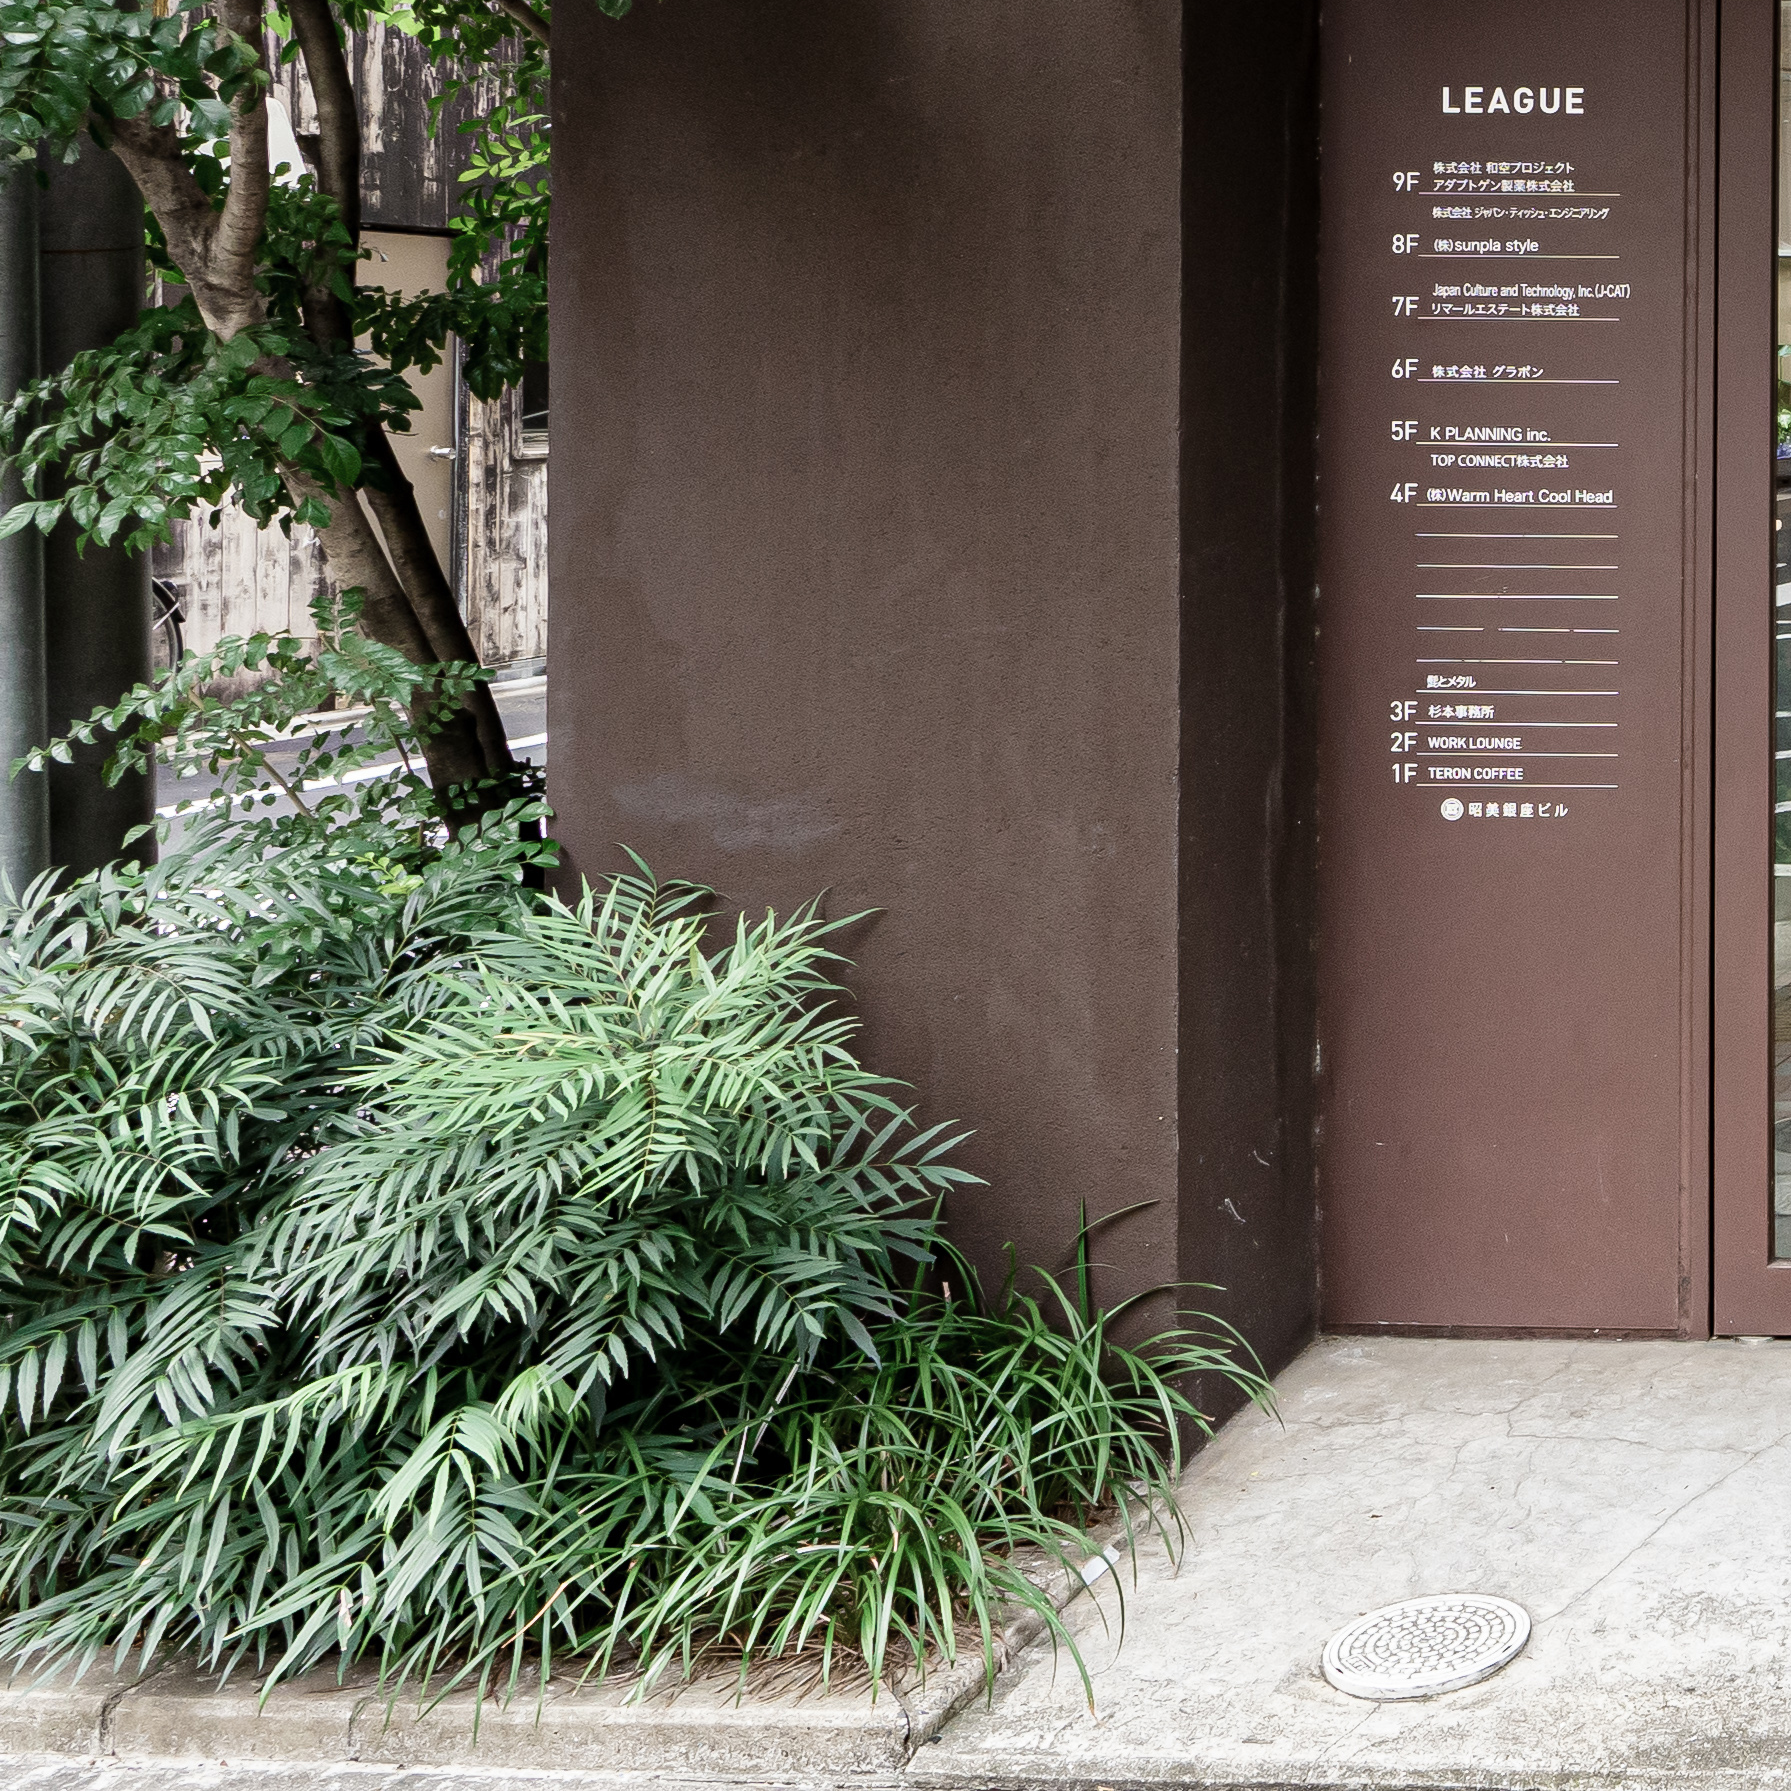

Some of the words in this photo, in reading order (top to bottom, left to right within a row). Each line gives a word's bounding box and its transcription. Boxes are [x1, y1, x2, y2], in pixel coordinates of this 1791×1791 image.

[1443, 87, 1584, 114] LEAGUE
[1393, 172, 1420, 191] 9F
[1392, 234, 1419, 253] 8F
[1506, 239, 1538, 254] style
[1433, 284, 1460, 298] Japan
[1463, 283, 1498, 296] Culture
[1501, 284, 1518, 296] and
[1393, 297, 1421, 318] 7F
[1392, 359, 1419, 378] 6F
[1433, 365, 1487, 378] 株式会社
[1392, 421, 1418, 440] 5F
[1431, 427, 1441, 440] K
[1446, 427, 1522, 441] PLANNING
[1527, 428, 1551, 441] inc.
[1431, 455, 1455, 466] TOP
[1390, 483, 1418, 503] 4F
[1495, 489, 1534, 502] Heart
[1539, 489, 1571, 503] Cool
[1576, 490, 1612, 503] Head
[1390, 701, 1418, 720] 3F
[1391, 732, 1418, 751] 2F
[1428, 737, 1466, 748] WORK
[1469, 738, 1522, 749] LOUNGE
[1392, 764, 1418, 783] 1F
[1428, 767, 1471, 779] TERON
[1474, 768, 1523, 780] COFFEE
